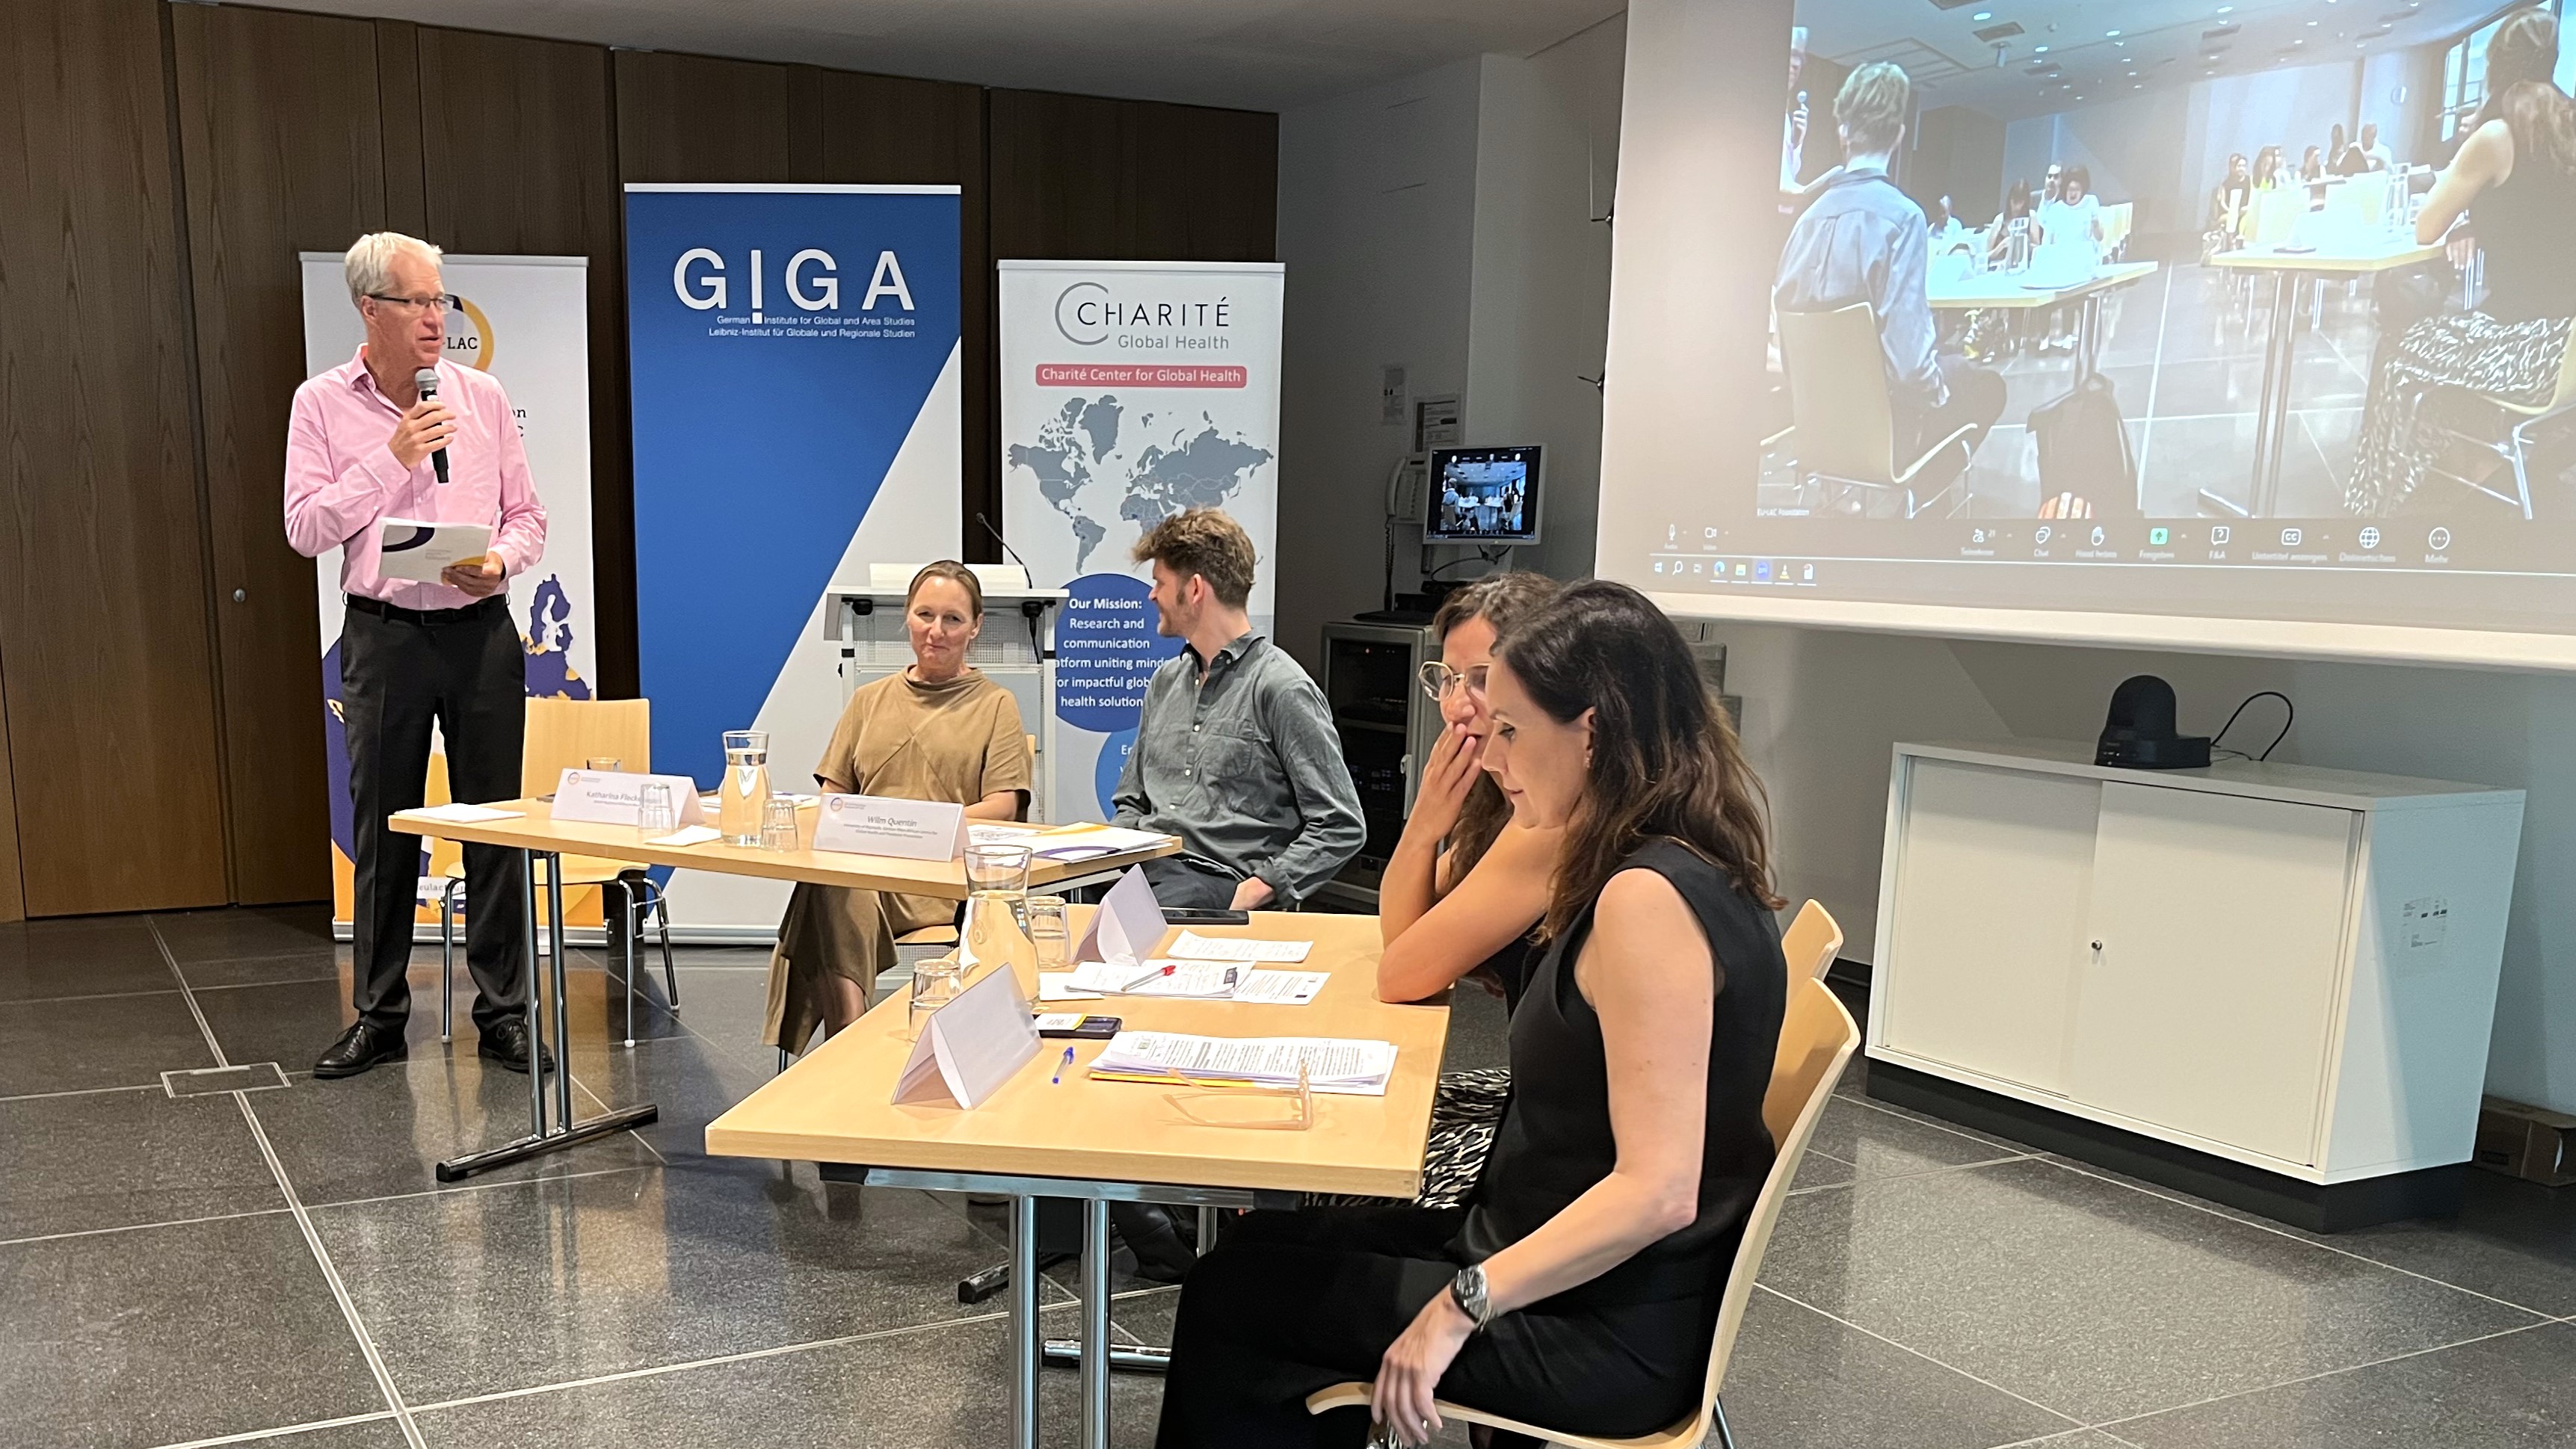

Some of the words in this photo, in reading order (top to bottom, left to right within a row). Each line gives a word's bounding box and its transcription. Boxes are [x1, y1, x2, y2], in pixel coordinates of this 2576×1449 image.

[1077, 296, 1230, 327] CHARITÉ
[717, 316, 751, 324] German
[764, 316, 798, 325] Institute
[800, 316, 811, 324] for
[814, 317, 841, 325] Global
[843, 317, 860, 325] and
[862, 318, 881, 326] Area
[883, 318, 915, 326] Studies
[709, 328, 770, 336] Leibniz-Institut
[772, 328, 784, 336] für
[786, 328, 819, 336] Globale
[821, 329, 837, 337] und
[839, 329, 881, 339] Regionale
[883, 330, 915, 338] Studien
[1118, 334, 1169, 349] Global
[1175, 335, 1229, 350] Health
[1041, 368, 1087, 381] Charité
[1090, 369, 1131, 381] Center
[1136, 368, 1153, 381] for
[1156, 369, 1197, 382] Global
[1201, 370, 1241, 383] Health
[1069, 598, 1091, 609] Our
[1094, 598, 1142, 609] Mission:
[1070, 618, 1120, 629] Research
[1123, 618, 1144, 629] and
[1063, 637, 1150, 649] communication
[1094, 658, 1133, 670] uniting
[1055, 676, 1069, 688] or
[1072, 676, 1124, 690] impactful
[1127, 676, 1150, 690] glob
[1061, 696, 1096, 707] health
